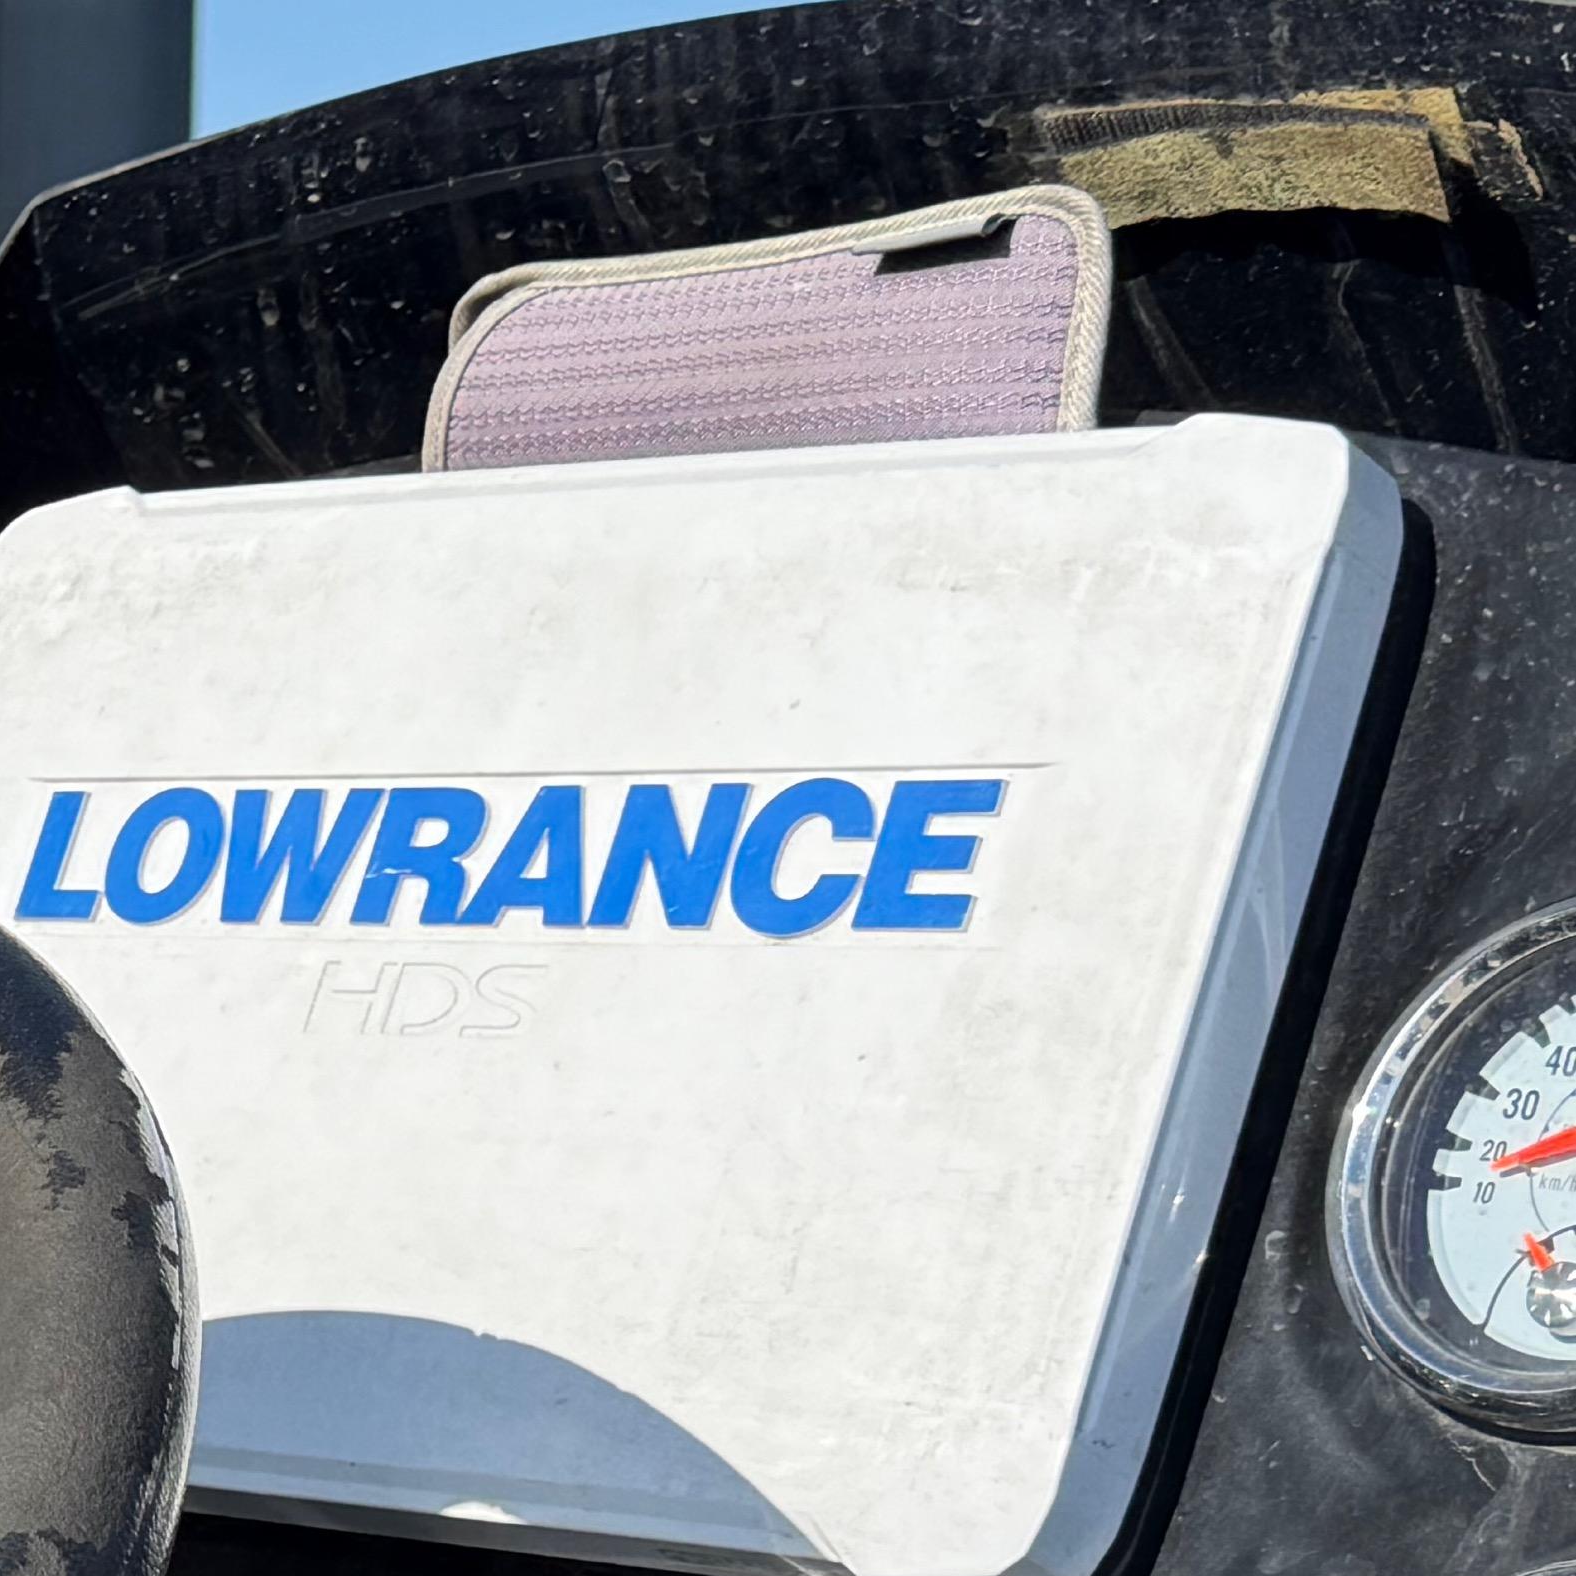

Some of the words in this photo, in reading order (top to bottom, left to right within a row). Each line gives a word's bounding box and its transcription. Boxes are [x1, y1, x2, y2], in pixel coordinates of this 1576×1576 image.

[14, 778, 1009, 938] LOWRANCE
[303, 960, 550, 1038] HDS
[1503, 1088, 1540, 1120] 30
[1479, 1140, 1507, 1162] 20
[1473, 1182, 1495, 1204] 10
